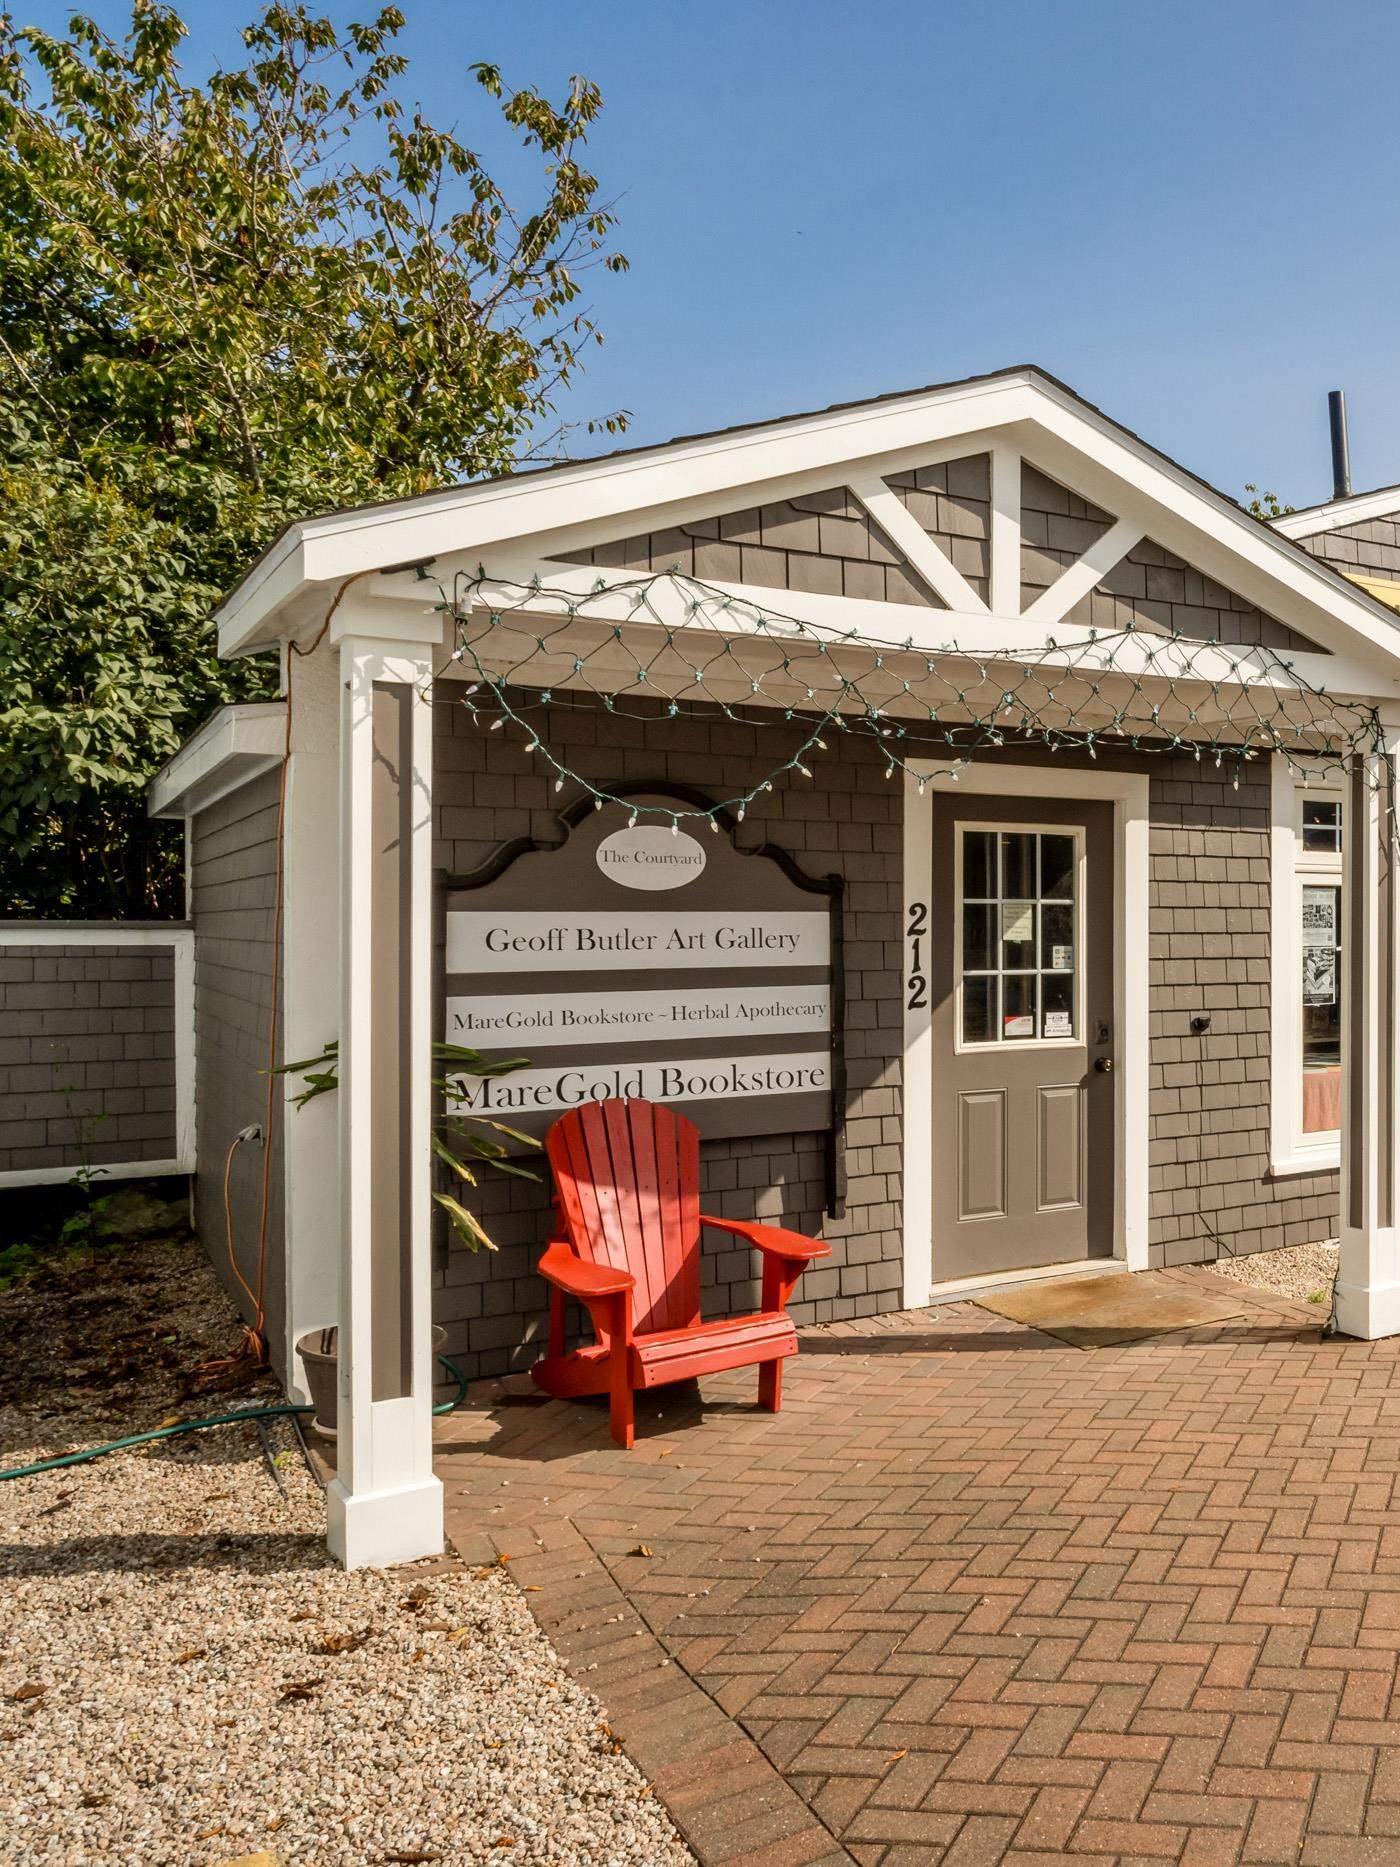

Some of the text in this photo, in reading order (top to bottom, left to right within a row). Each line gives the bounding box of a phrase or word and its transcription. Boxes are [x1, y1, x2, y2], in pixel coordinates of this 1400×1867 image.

[600, 850, 702, 867] The Courtyard
[485, 926, 801, 953] Geoff Butler Art Gallery
[907, 902, 928, 1011] 212
[453, 1010, 554, 1031] MareGold
[561, 1006, 655, 1027] Bookstore
[671, 1004, 730, 1022] Herbal
[735, 1001, 827, 1023] Apothecary
[452, 1064, 826, 1111] MareGold Bookstore
